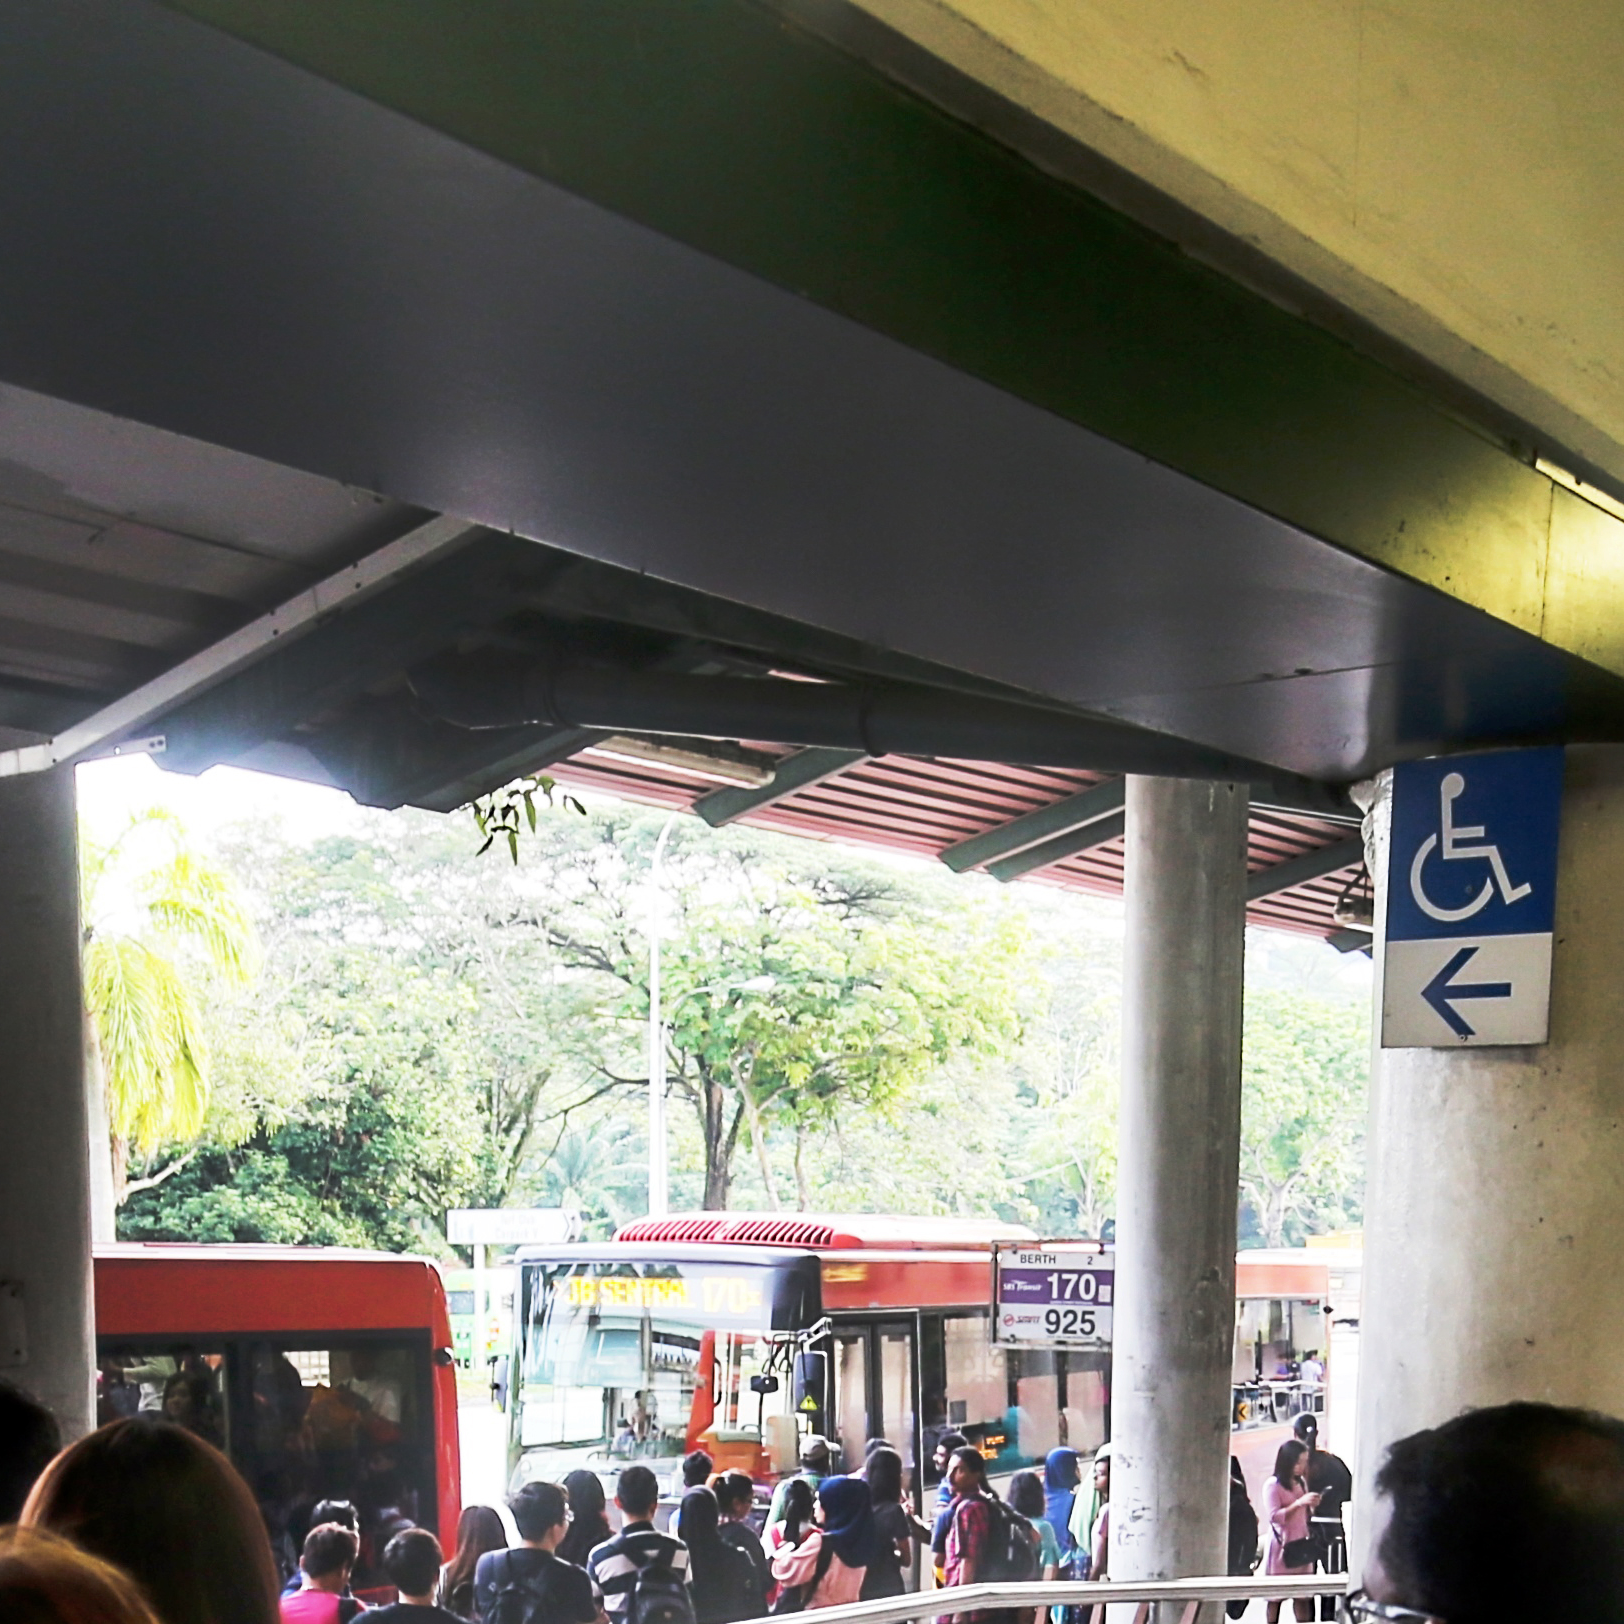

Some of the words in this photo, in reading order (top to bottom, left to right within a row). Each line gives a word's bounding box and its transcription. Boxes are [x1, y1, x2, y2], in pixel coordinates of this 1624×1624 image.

[1020, 1254, 1056, 1264] BERTH
[1087, 1256, 1093, 1265] 2
[565, 1277, 596, 1306] JB
[599, 1277, 696, 1308] SENTRAL
[1047, 1272, 1096, 1300] 170
[1045, 1309, 1095, 1335] 925
